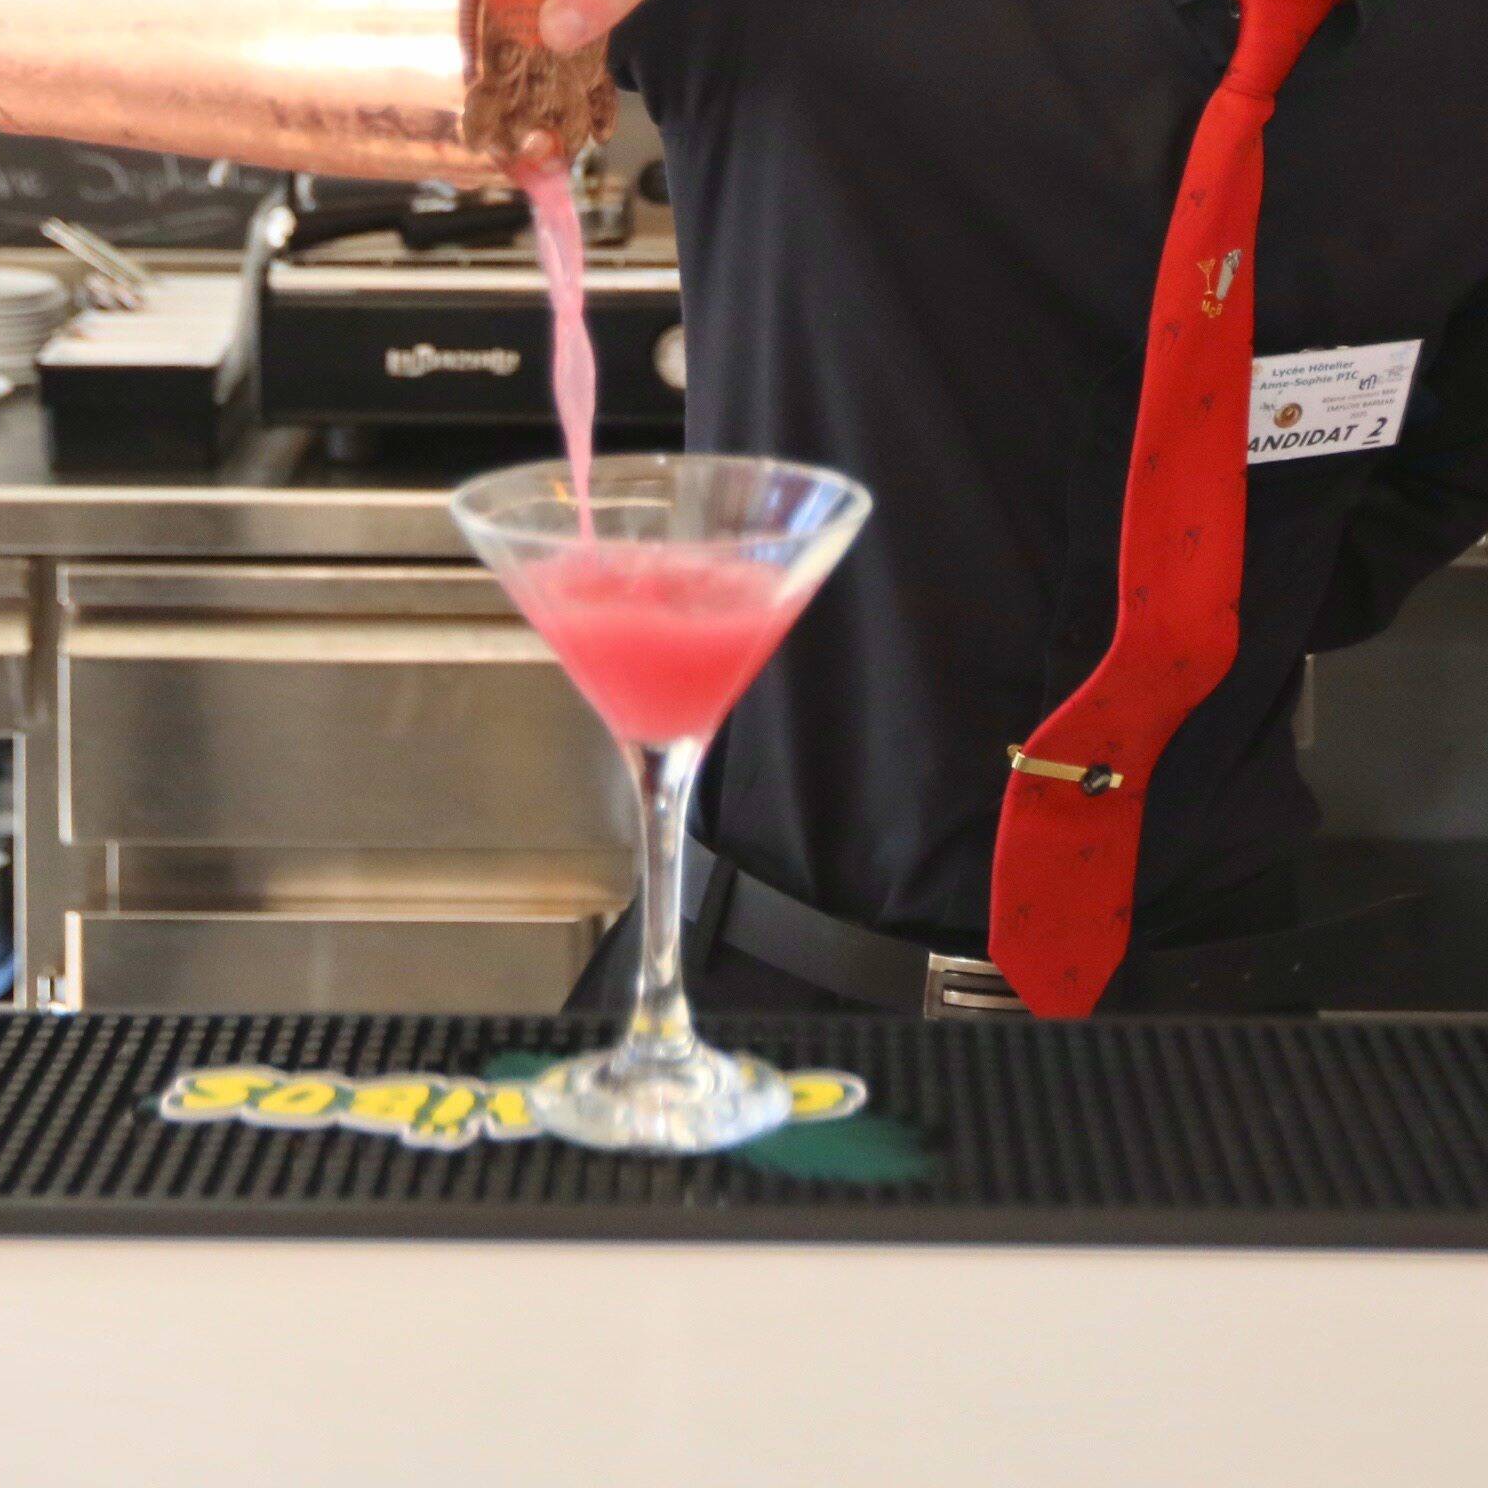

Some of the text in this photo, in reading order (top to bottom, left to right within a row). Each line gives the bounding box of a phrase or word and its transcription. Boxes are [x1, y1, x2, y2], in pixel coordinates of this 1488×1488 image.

[1336, 371, 1360, 382] PIC
[1247, 417, 1388, 454] ANDIDAT 2
